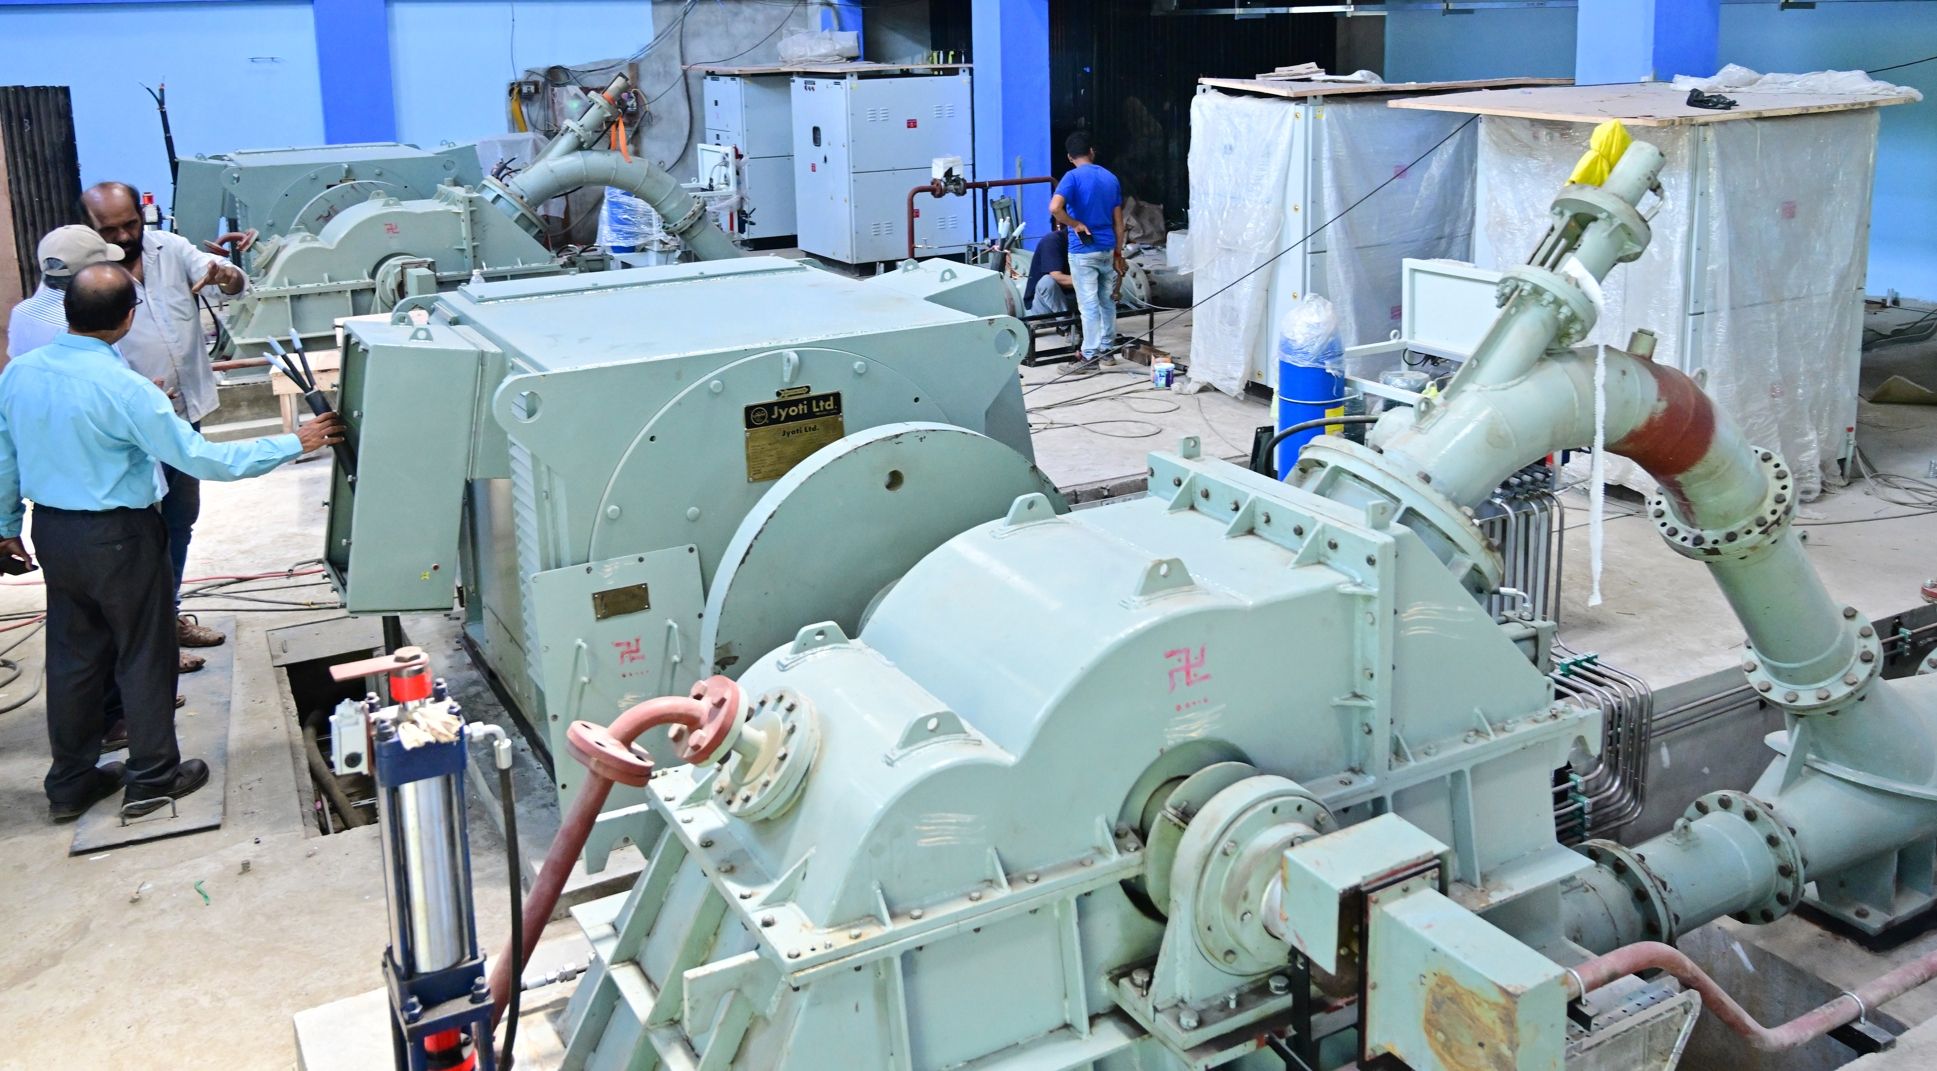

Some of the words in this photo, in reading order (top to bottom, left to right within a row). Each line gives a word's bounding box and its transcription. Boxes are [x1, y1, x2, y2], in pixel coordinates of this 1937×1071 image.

[771, 401, 808, 421] Jyoti
[812, 396, 838, 412] Ltd.
[781, 427, 802, 437] Jyoti
[804, 425, 819, 433] Ltd.
